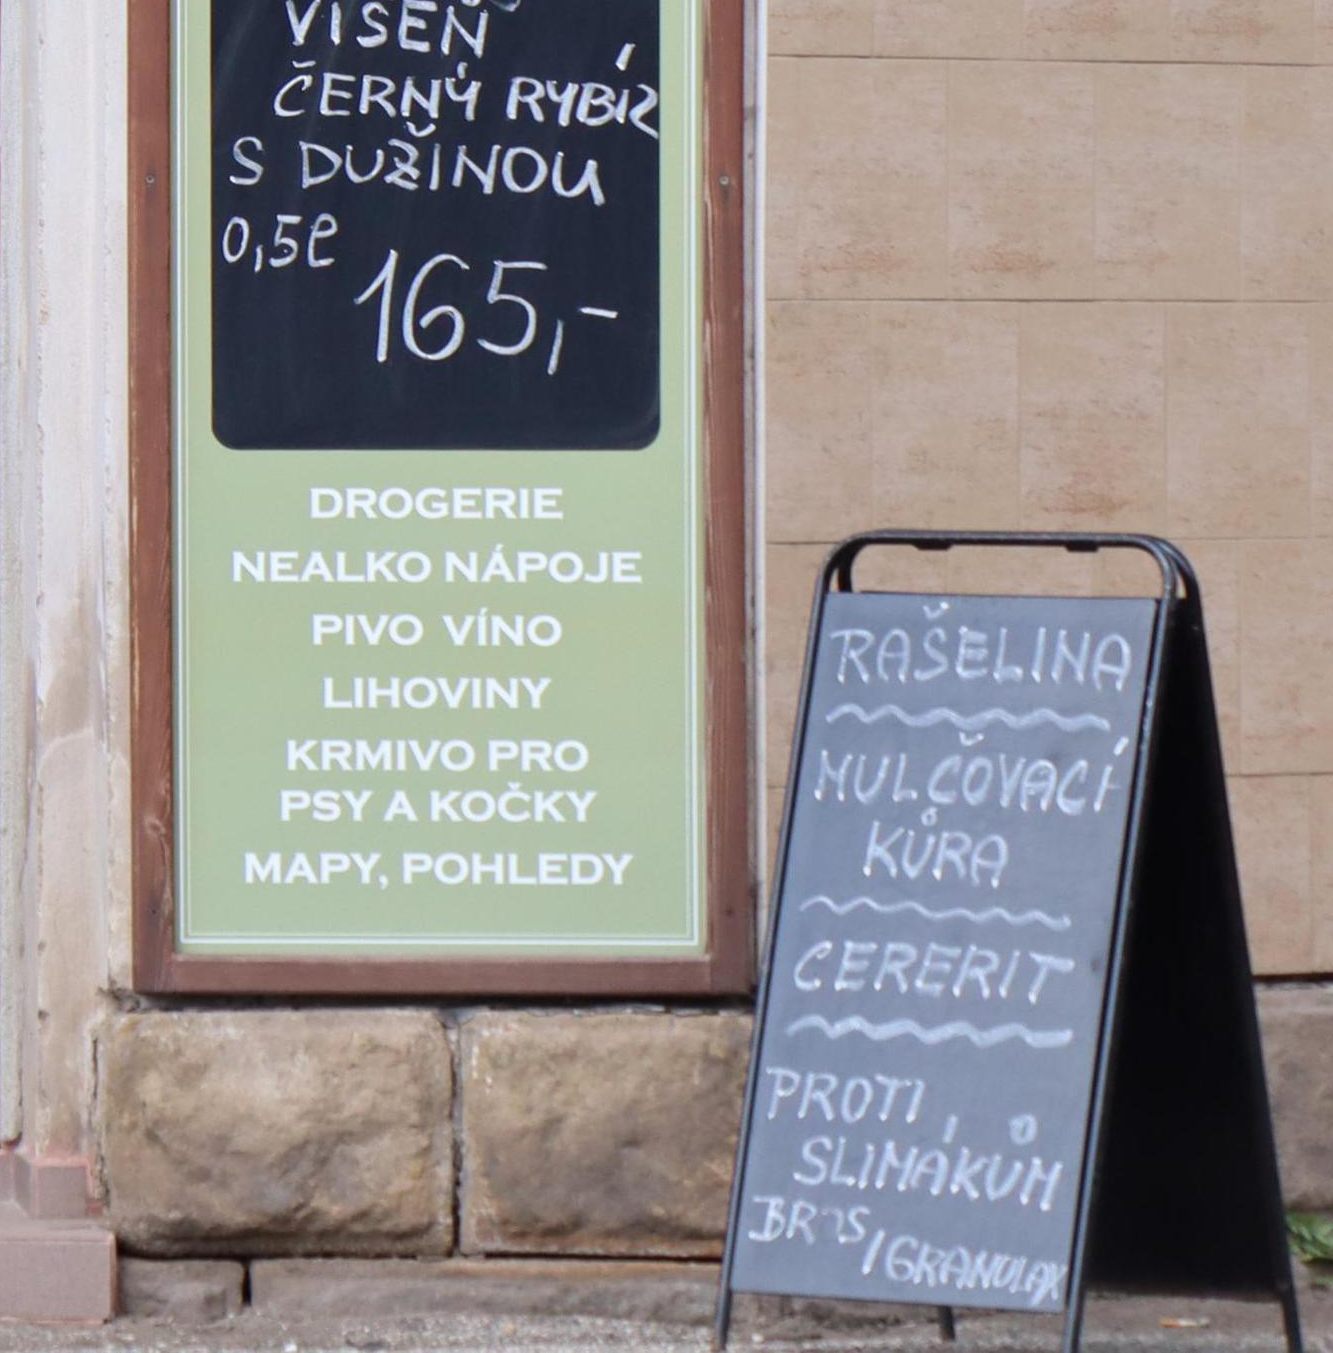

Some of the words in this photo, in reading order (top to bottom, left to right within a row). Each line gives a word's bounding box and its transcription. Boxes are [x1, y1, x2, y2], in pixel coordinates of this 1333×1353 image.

[274, 60, 481, 122] ČERNÝ
[230, 136, 263, 185] S
[299, 122, 605, 206] DUŽINOU
[310, 487, 563, 520] DROGERIE
[231, 550, 432, 583] NEALKO
[445, 544, 643, 583] NÁPOJE
[312, 614, 424, 646] PIVO
[442, 608, 562, 646] VÍNO
[830, 601, 1131, 691] RAŠELINA
[322, 677, 551, 709] LIHOVINY
[286, 739, 474, 772] KRMIVO
[488, 739, 589, 772] PRO
[814, 731, 1130, 816] MULČOVACÍ
[280, 790, 372, 822] PSY
[384, 791, 418, 822] A
[431, 782, 597, 822] KOČKY
[244, 852, 388, 889] MAPY,
[402, 852, 634, 886] POHLEDY
[863, 806, 1009, 889] KŮRA
[793, 940, 1075, 1005] CERERIT
[766, 1066, 924, 1124] PROTI
[793, 1113, 1064, 1212] SLIMÁKŮM
